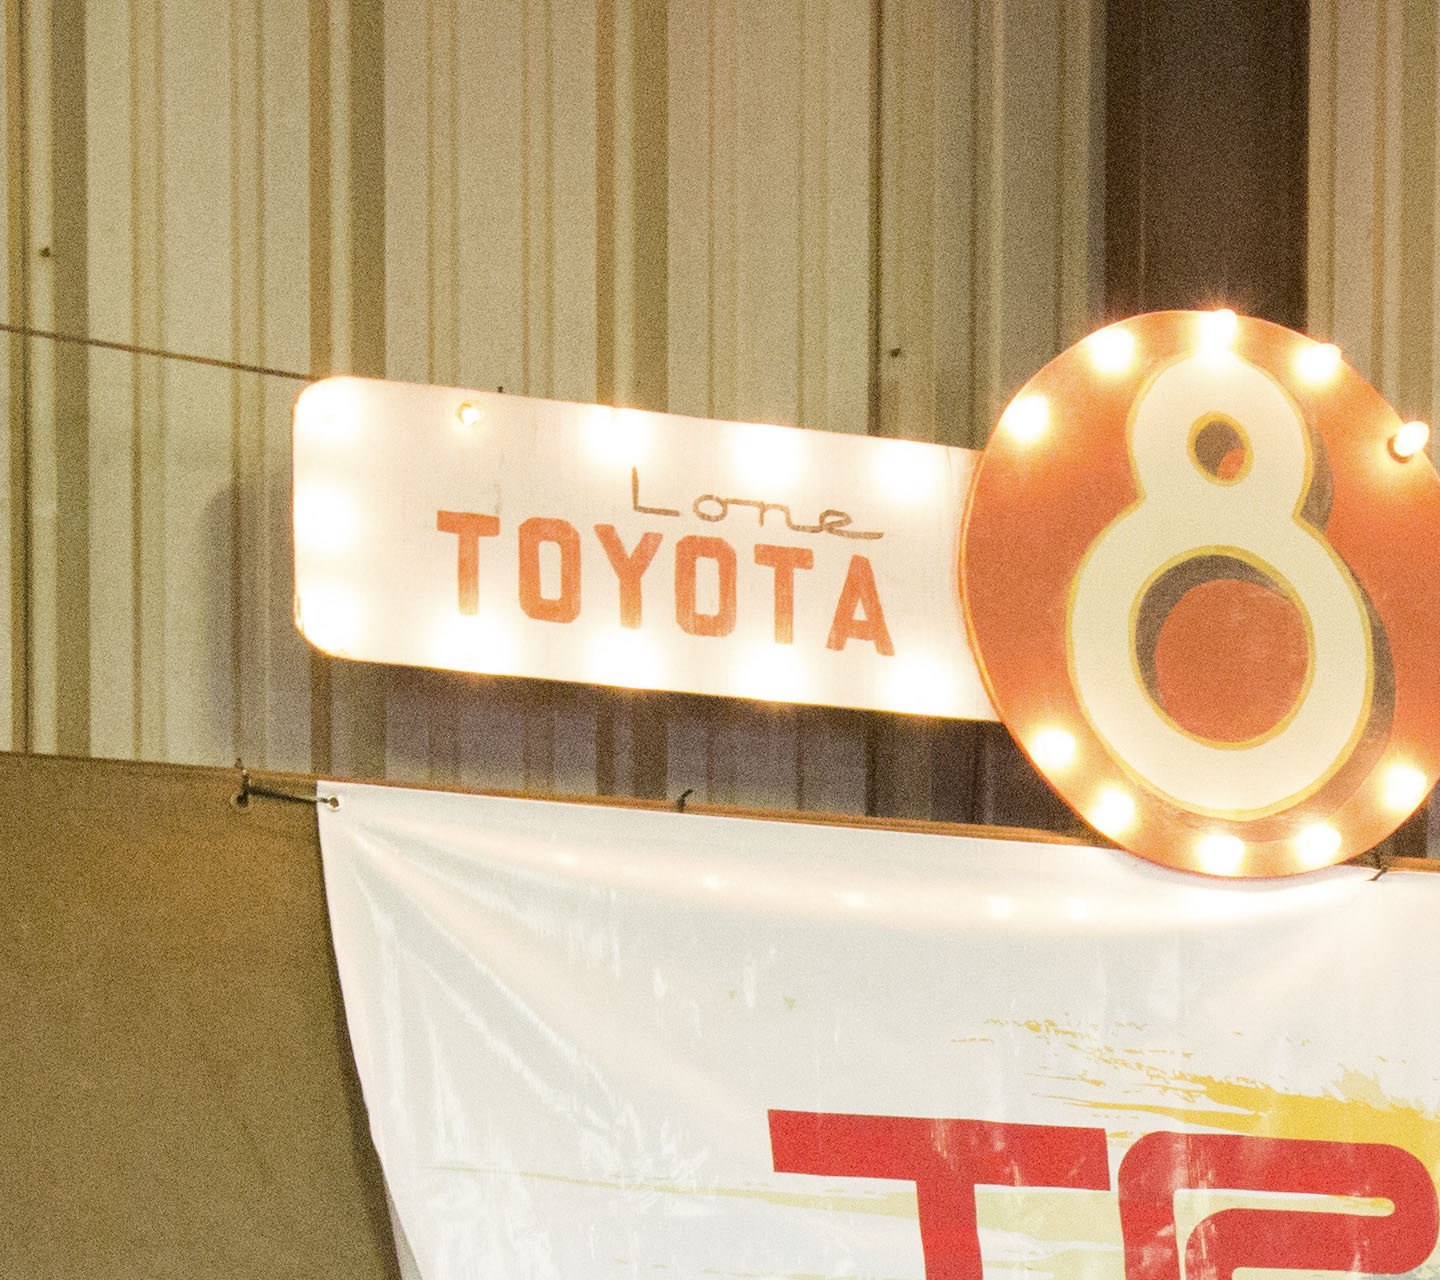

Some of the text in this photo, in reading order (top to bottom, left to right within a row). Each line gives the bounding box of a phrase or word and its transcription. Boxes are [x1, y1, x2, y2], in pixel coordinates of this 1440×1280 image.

[632, 466, 884, 540] Lone
[436, 510, 895, 656] TOYOTA
[1069, 353, 1378, 822] 8
